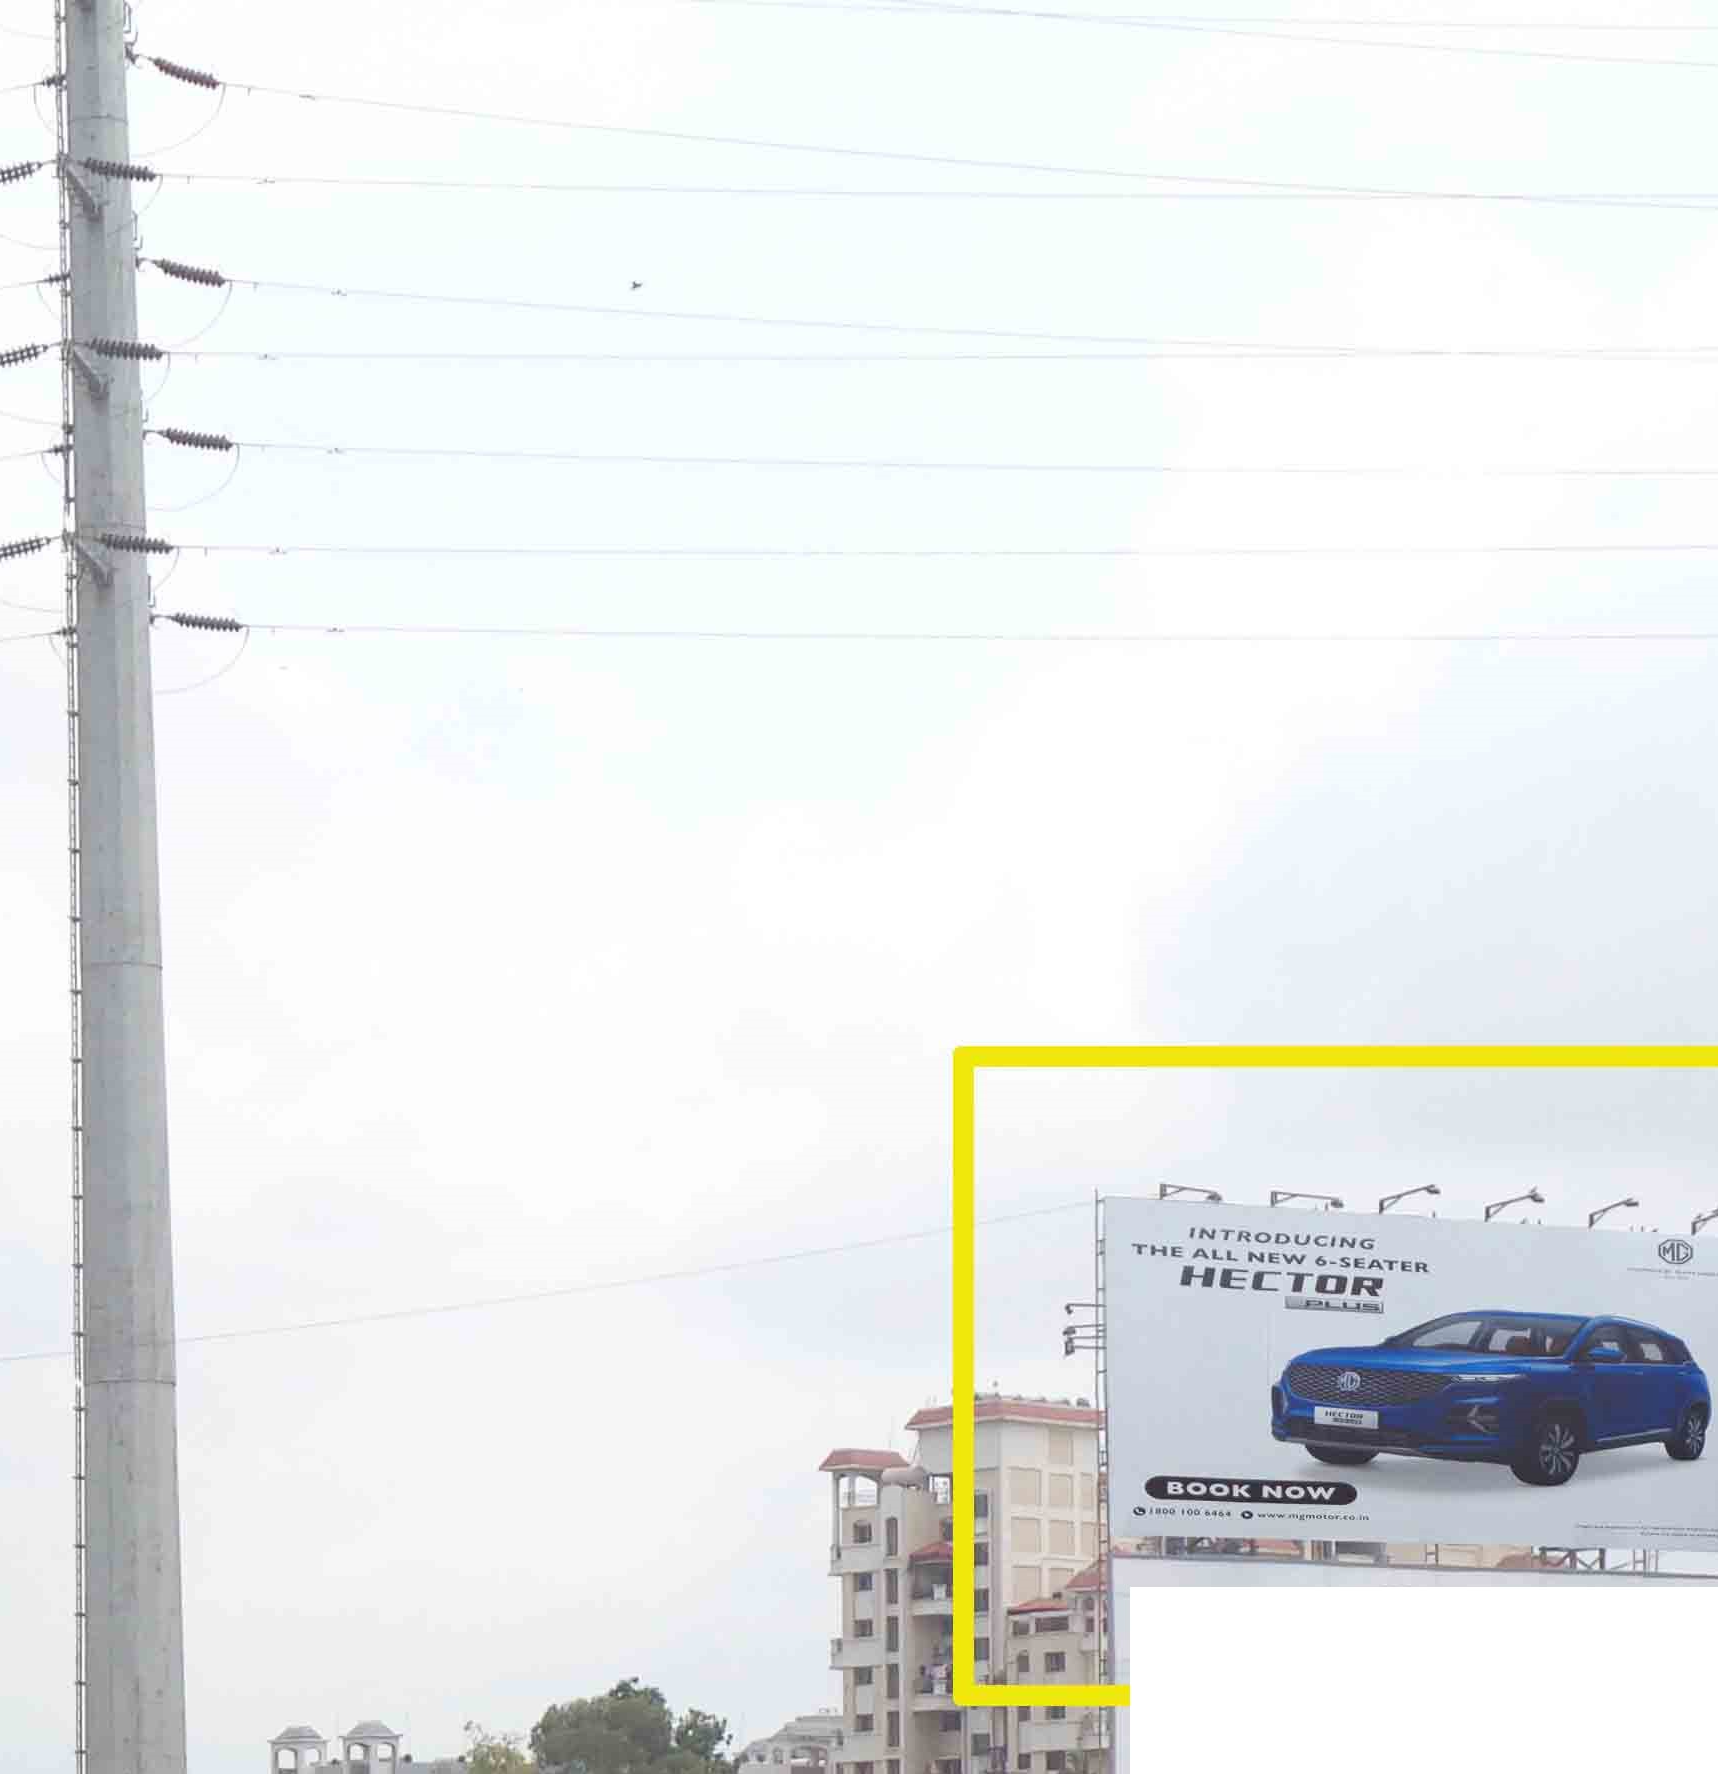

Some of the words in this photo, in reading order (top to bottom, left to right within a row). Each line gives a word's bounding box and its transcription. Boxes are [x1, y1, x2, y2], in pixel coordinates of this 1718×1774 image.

[1188, 1226, 1377, 1251] INTRODUCING
[1131, 1243, 1184, 1259] THE
[1191, 1247, 1239, 1262] ALL
[1247, 1252, 1307, 1266] NEW
[1314, 1255, 1431, 1274] 6-SEATER
[1179, 1265, 1385, 1298] HECTOR
[1304, 1299, 1382, 1313] PLUS
[1166, 1481, 1252, 1498] BOOK
[1261, 1484, 1337, 1501] NOW
[1148, 1507, 1176, 1516] 1800
[1181, 1508, 1201, 1517] 100
